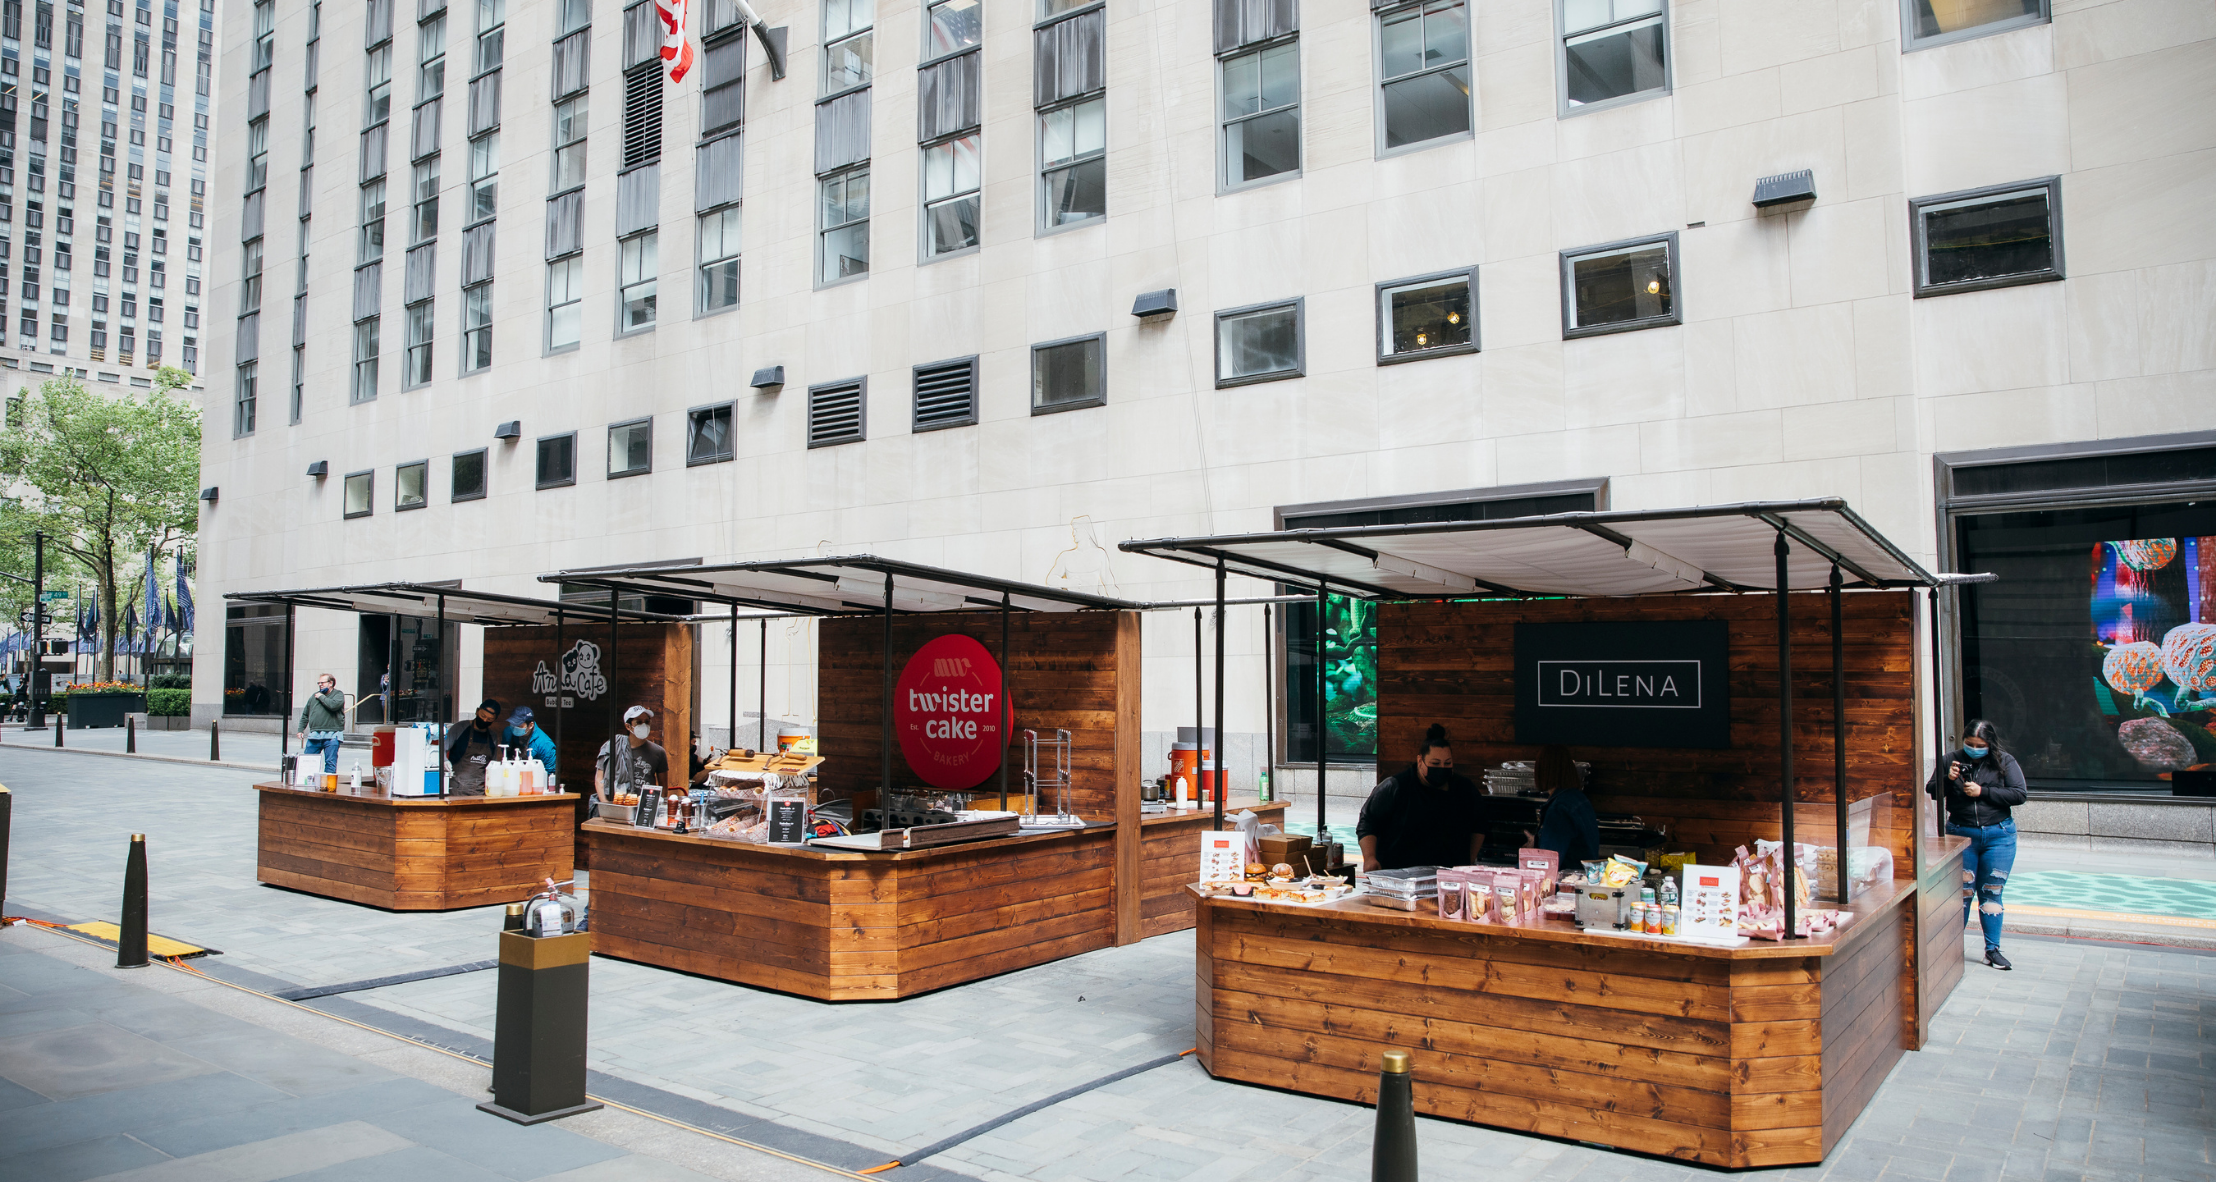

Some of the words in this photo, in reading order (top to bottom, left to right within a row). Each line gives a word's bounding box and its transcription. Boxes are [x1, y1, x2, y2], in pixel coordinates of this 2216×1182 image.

[534, 661, 576, 690] Ana
[577, 665, 605, 698] Cafe
[909, 685, 994, 713] twister
[910, 723, 920, 731] Est.
[925, 716, 977, 739] cake
[933, 751, 970, 767] BAKERY
